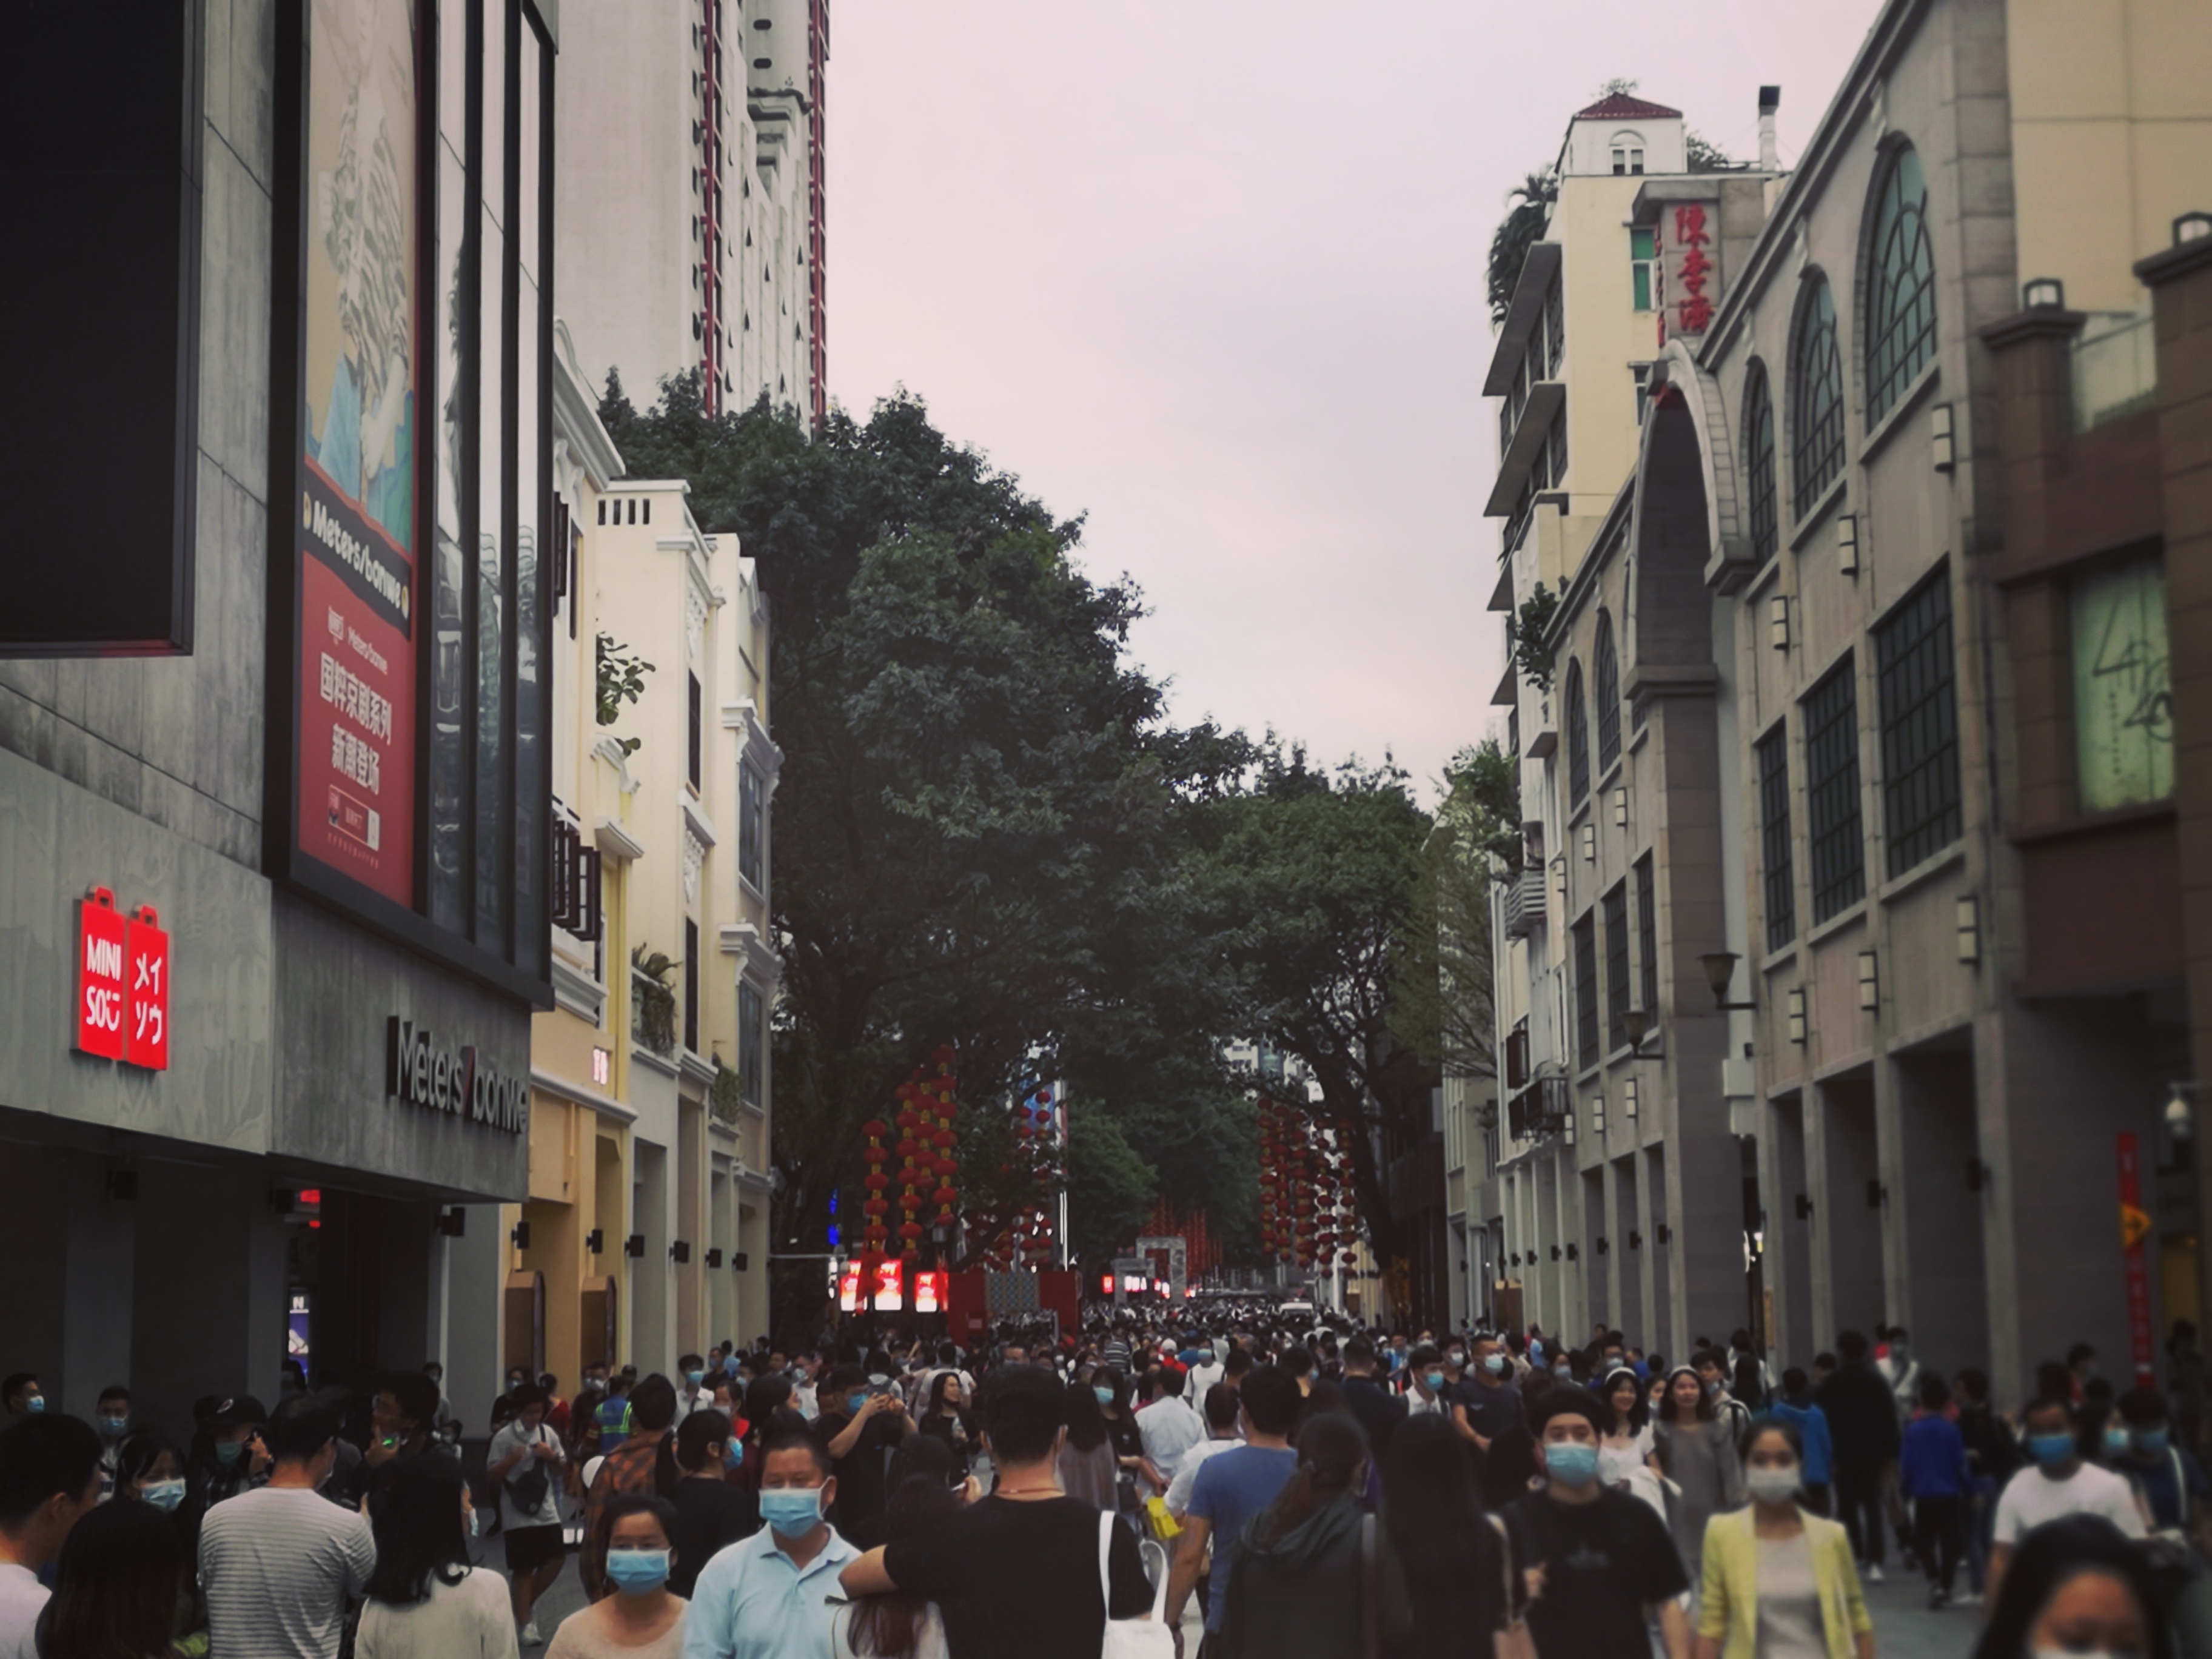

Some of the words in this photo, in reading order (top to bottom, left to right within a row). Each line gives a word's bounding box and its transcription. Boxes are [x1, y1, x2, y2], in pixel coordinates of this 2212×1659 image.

[87, 934, 121, 981] MINI
[134, 953, 162, 996] メイ
[136, 1001, 162, 1045] ソウ
